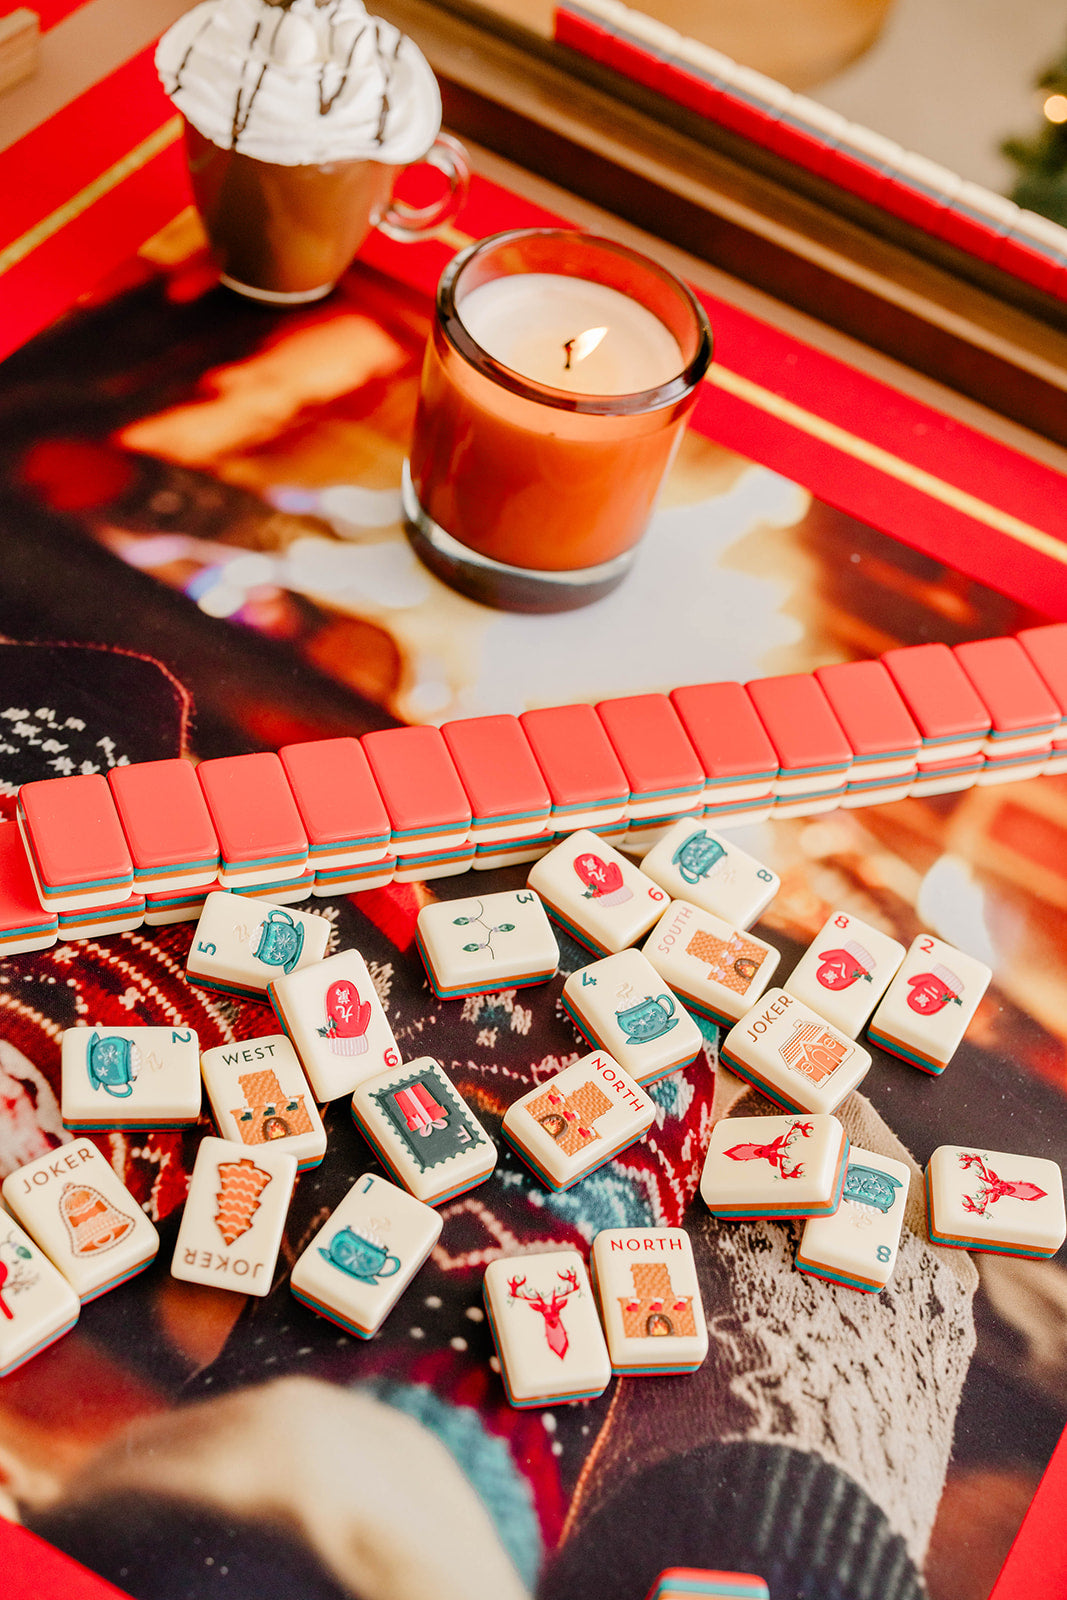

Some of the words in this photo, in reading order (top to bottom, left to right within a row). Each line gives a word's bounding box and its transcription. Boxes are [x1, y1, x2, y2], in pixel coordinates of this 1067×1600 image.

[757, 869, 773, 882] 8
[516, 892, 534, 905] 3
[657, 907, 693, 954] SOUTH
[834, 915, 849, 929] 8
[197, 941, 217, 956] 5
[920, 938, 934, 954] 2
[582, 971, 597, 987] 4
[747, 994, 793, 1043] JOKER
[172, 1031, 191, 1044] 2
[222, 1044, 275, 1066] WEST
[590, 1057, 645, 1112] NORTH
[457, 1124, 472, 1144] F
[23, 1147, 94, 1194] JOKER
[610, 1238, 682, 1251] NORTH
[876, 1245, 892, 1263] 8
[184, 1248, 264, 1278] JOKER
